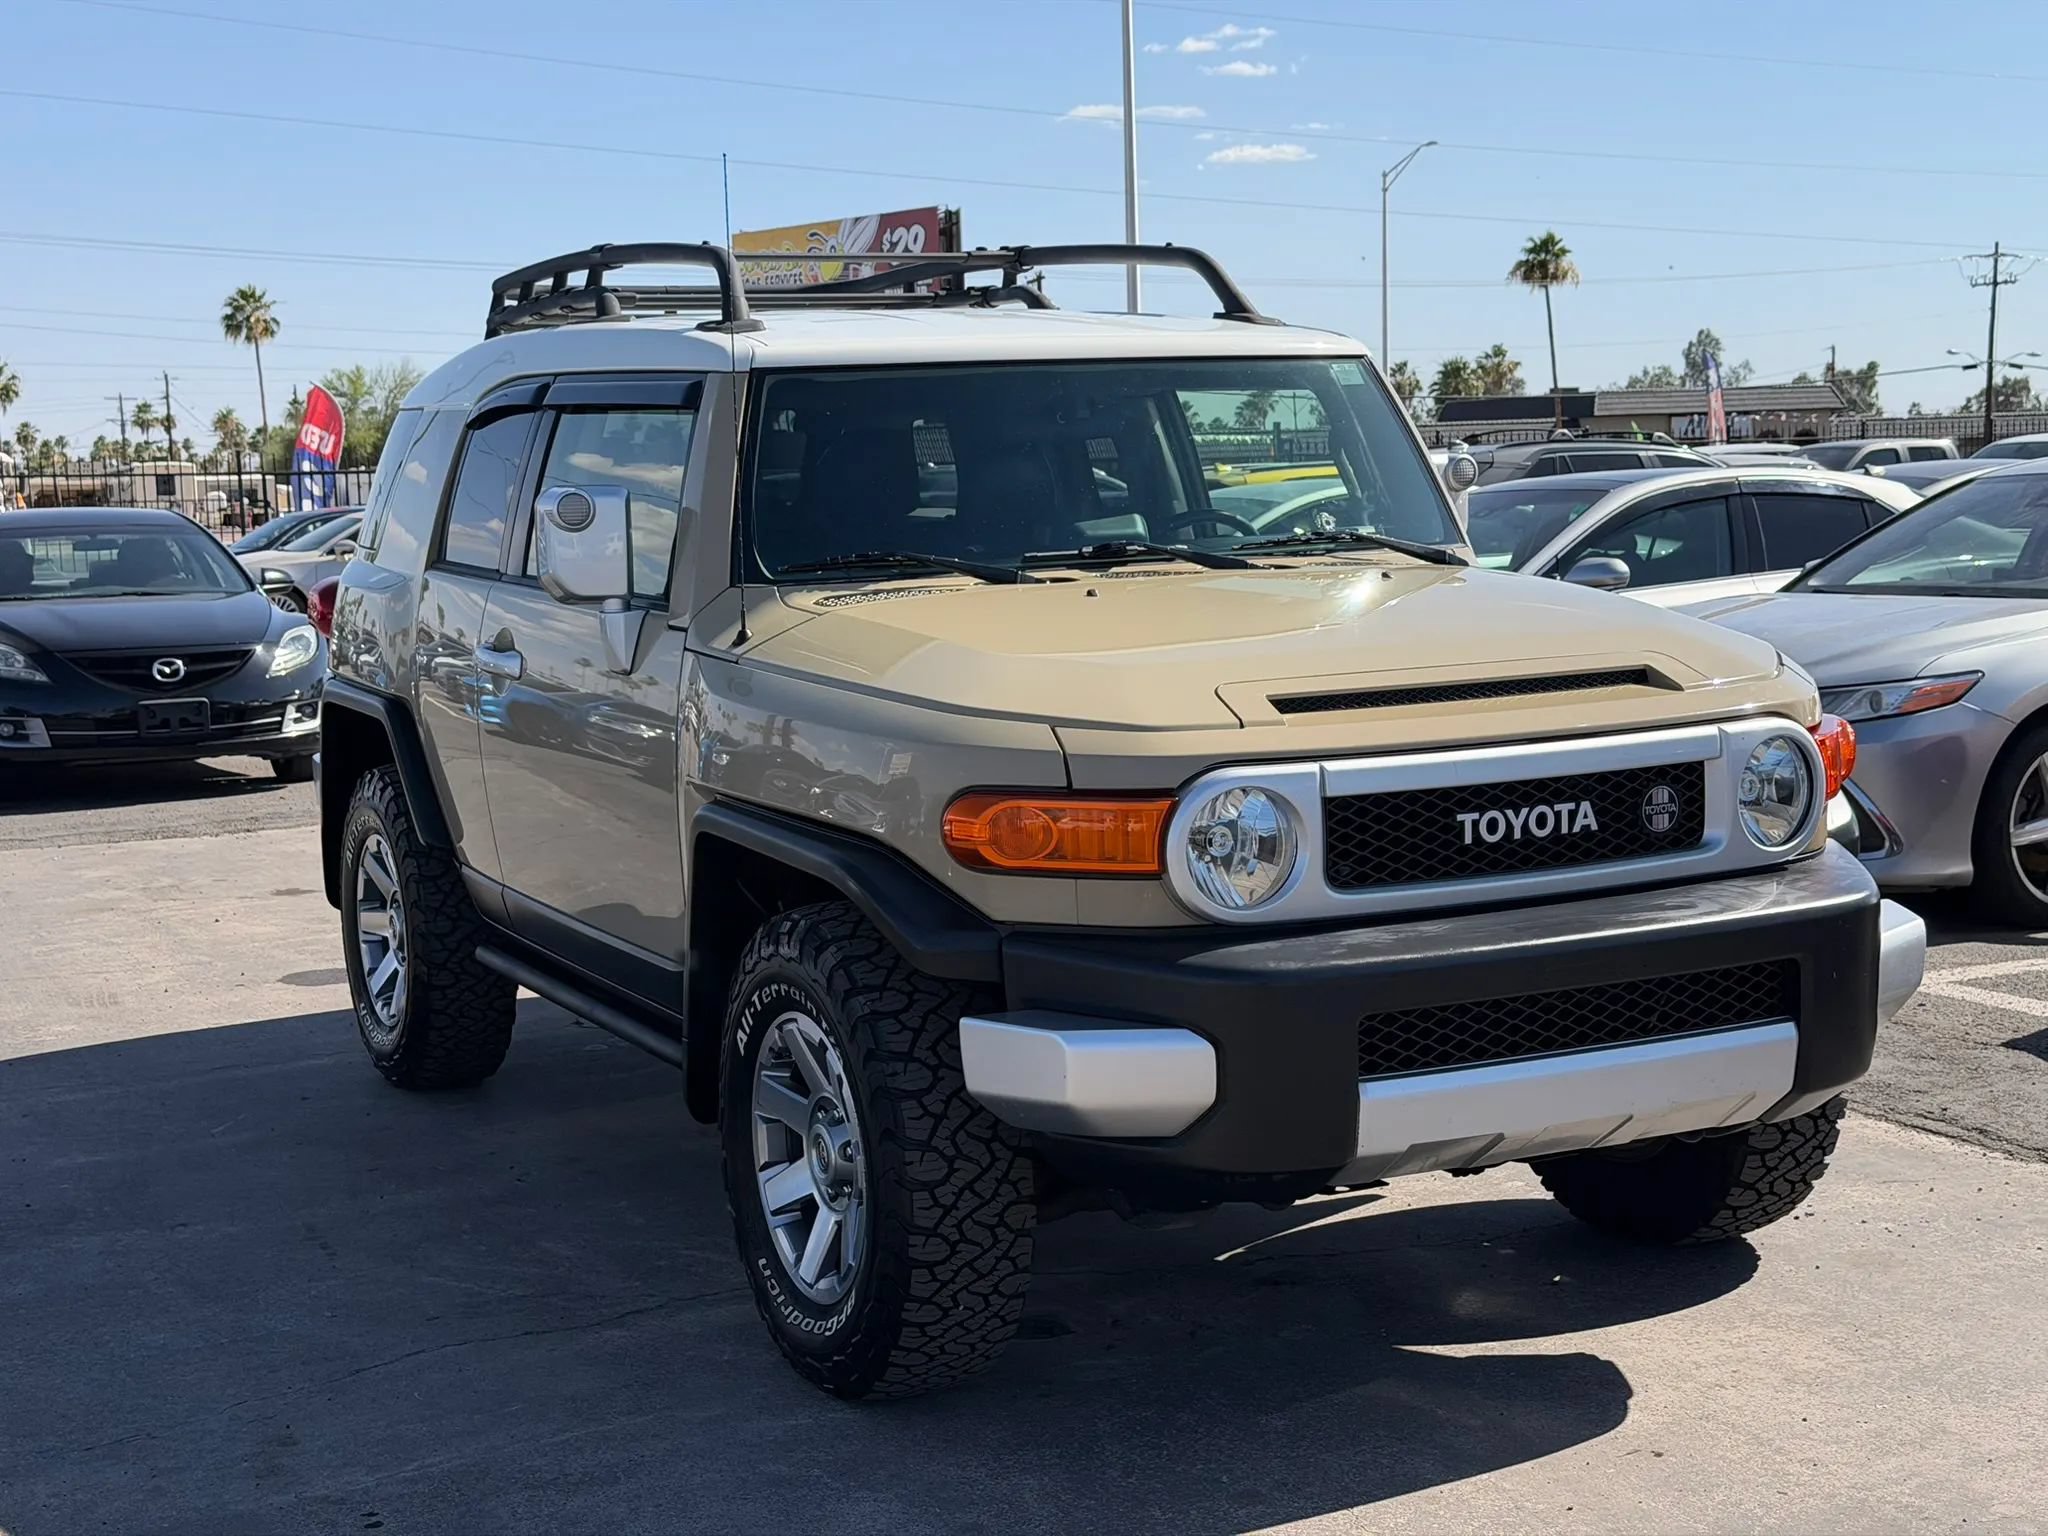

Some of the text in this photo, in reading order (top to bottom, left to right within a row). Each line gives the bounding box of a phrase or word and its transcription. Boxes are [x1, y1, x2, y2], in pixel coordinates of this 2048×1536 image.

[1456, 800, 1598, 844] TOYOTA
[1644, 803, 1677, 815] TOYOTA
[736, 983, 817, 1057] All-Terrain
